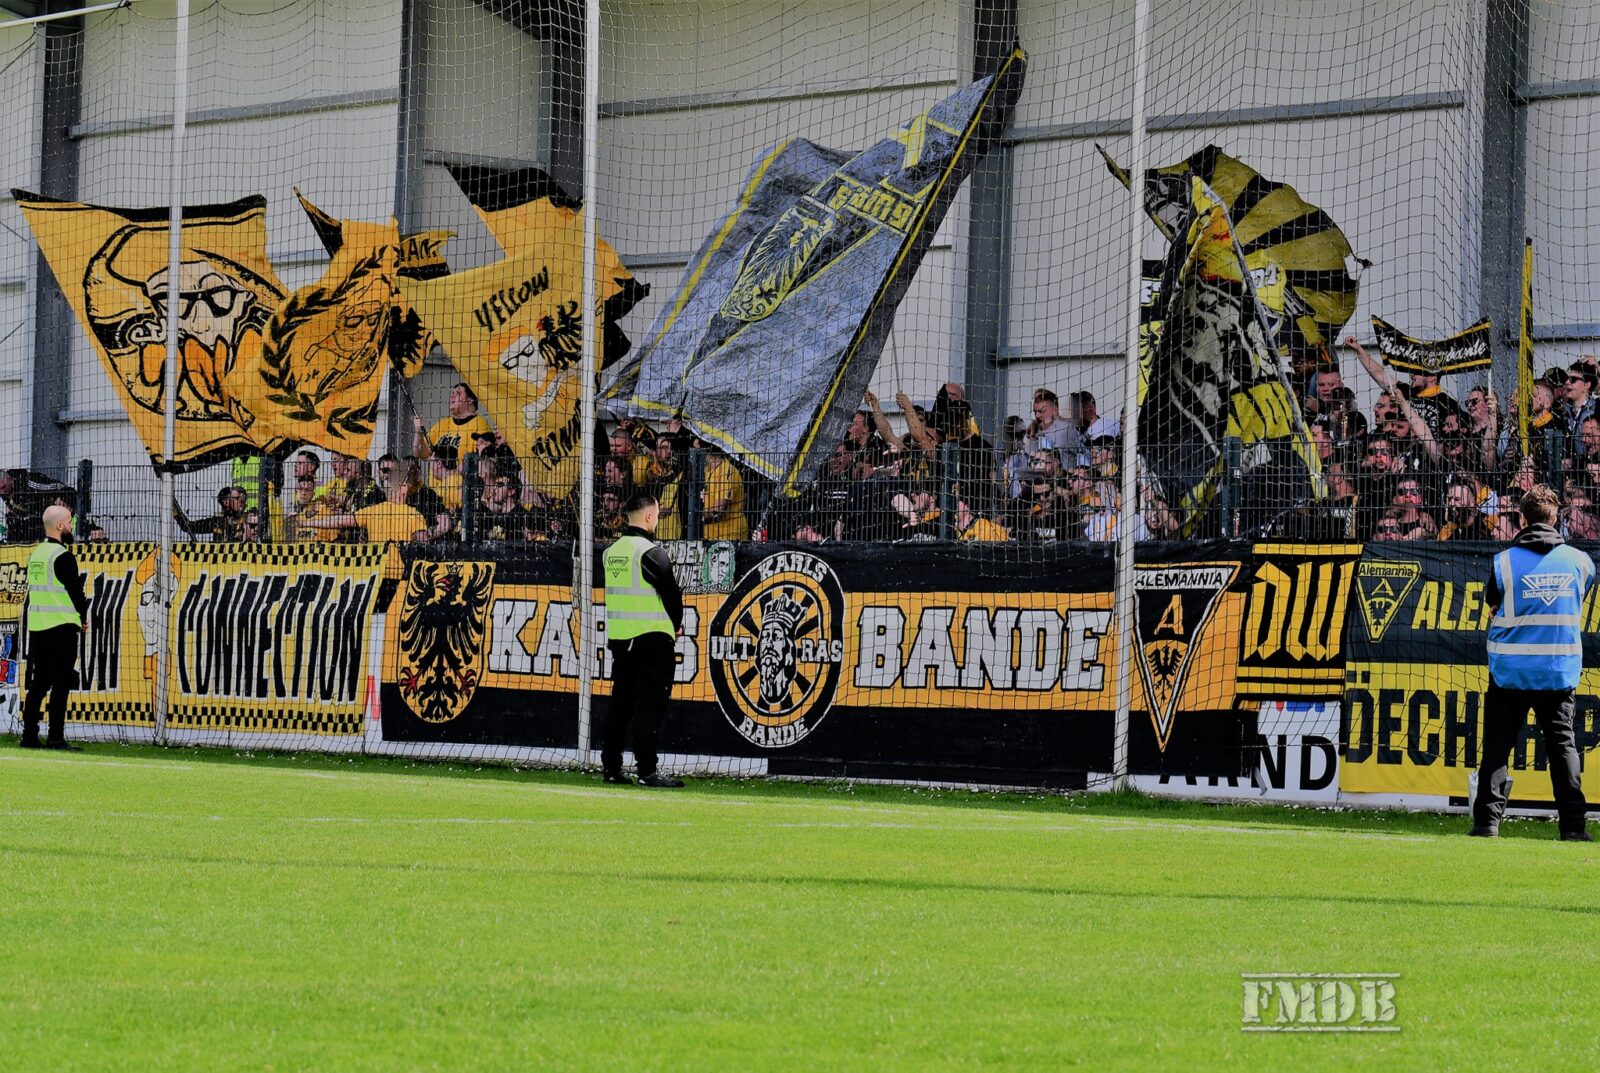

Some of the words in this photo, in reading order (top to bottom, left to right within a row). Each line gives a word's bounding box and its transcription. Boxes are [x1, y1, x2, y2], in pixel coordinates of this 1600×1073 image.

[474, 265, 549, 333] YELLOW
[759, 553, 829, 583] KARLS
[1134, 571, 1224, 588] ALEMANNIA
[1358, 563, 1414, 578] Alemannia
[1154, 594, 1185, 636] A
[177, 572, 378, 702] CONNECTION
[853, 605, 1114, 691] BANDE
[739, 715, 807, 748] BANDE
